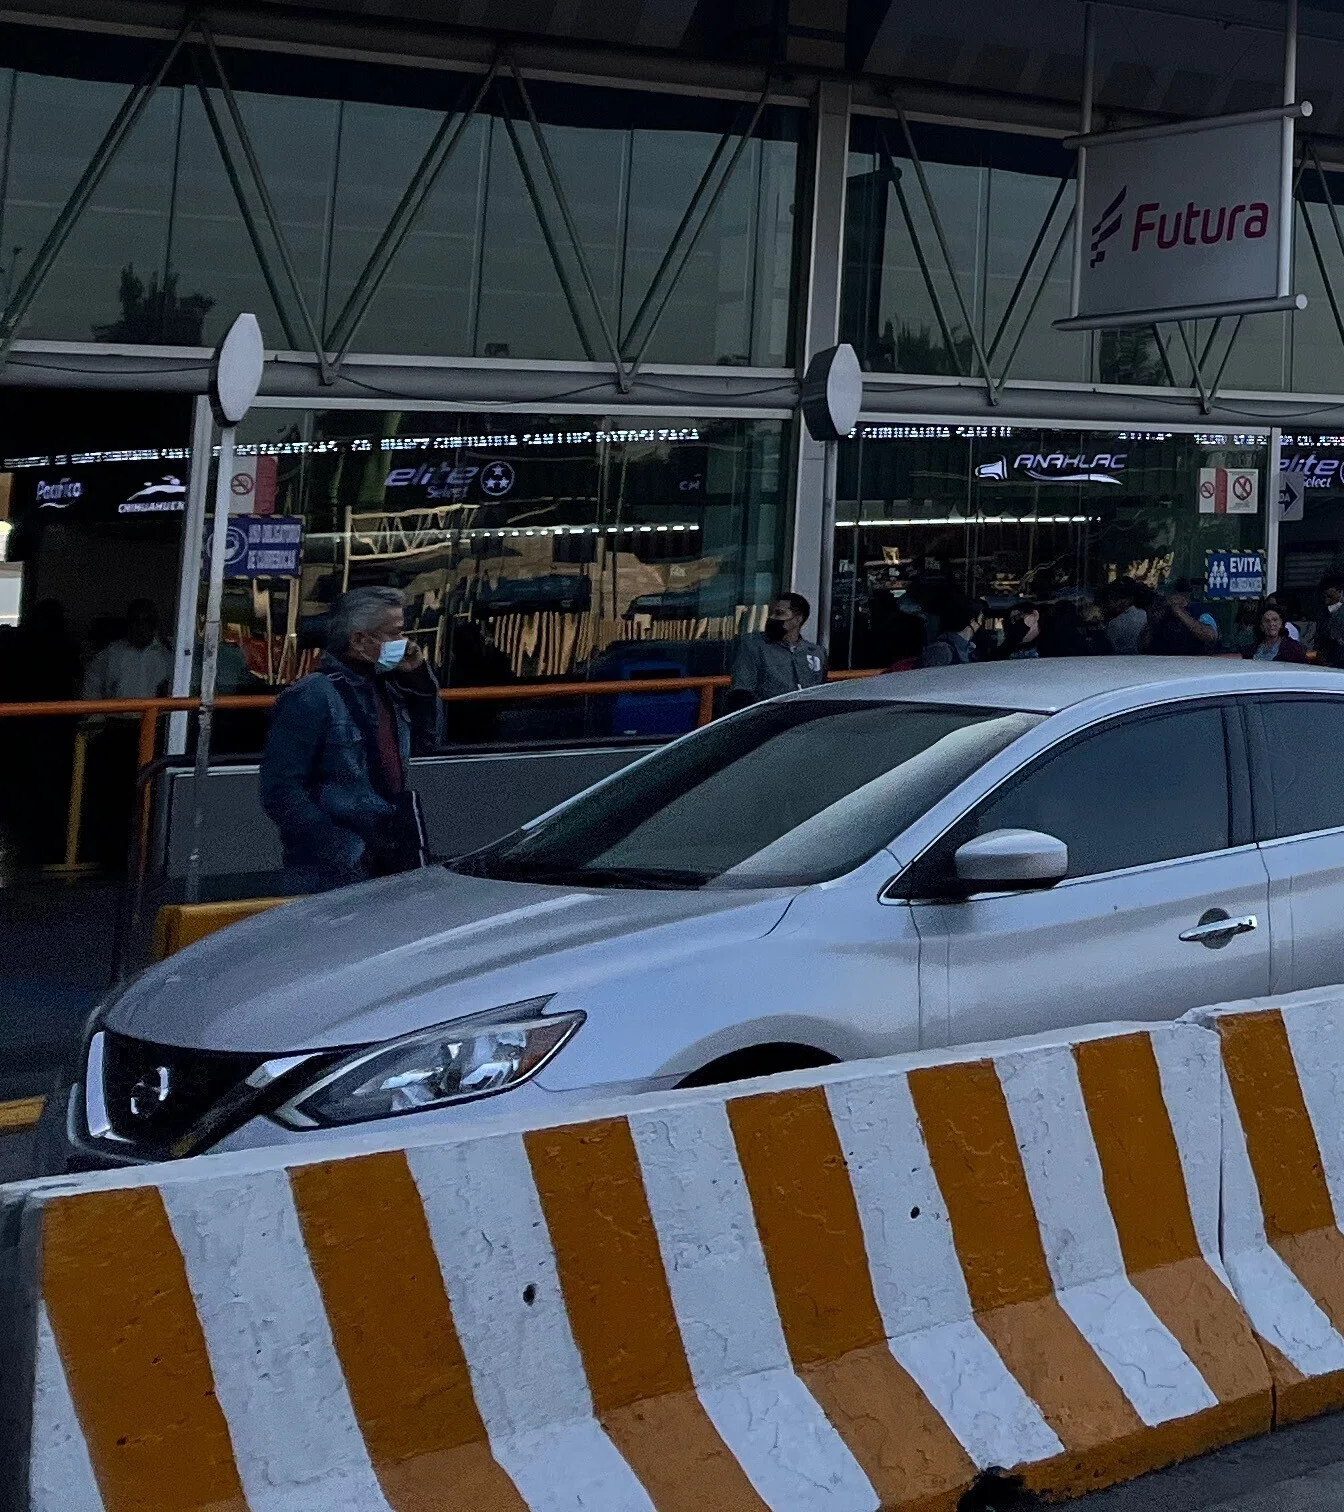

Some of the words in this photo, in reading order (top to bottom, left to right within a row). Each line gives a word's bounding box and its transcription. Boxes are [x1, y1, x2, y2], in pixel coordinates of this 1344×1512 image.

[1131, 201, 1270, 252] Futura
[384, 461, 480, 487] elite
[1229, 557, 1262, 573] EVITA
